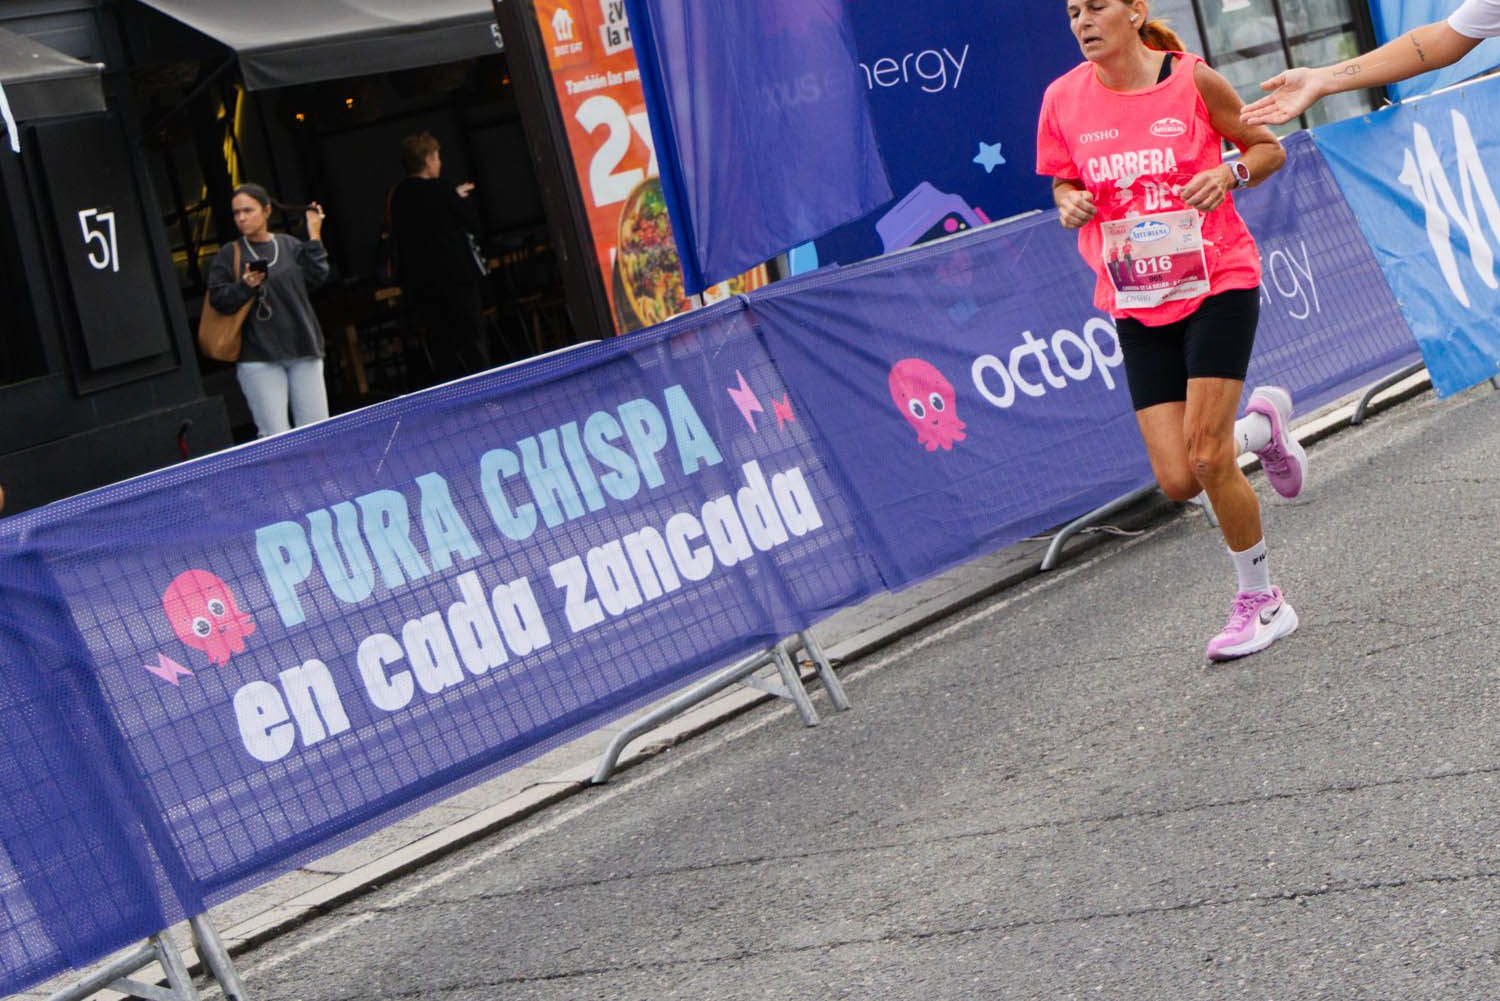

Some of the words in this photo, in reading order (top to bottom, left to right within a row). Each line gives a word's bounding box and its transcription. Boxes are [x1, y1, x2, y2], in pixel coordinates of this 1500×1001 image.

[1079, 128, 1119, 144] OYSHO
[1088, 147, 1178, 183] CARRERA
[78, 208, 119, 272] 57
[1135, 256, 1173, 274] 016
[255, 472, 480, 628] PURA
[480, 384, 724, 542] CHISPA
[231, 656, 350, 764] en
[356, 569, 550, 712] cada
[550, 459, 824, 634] zancada
